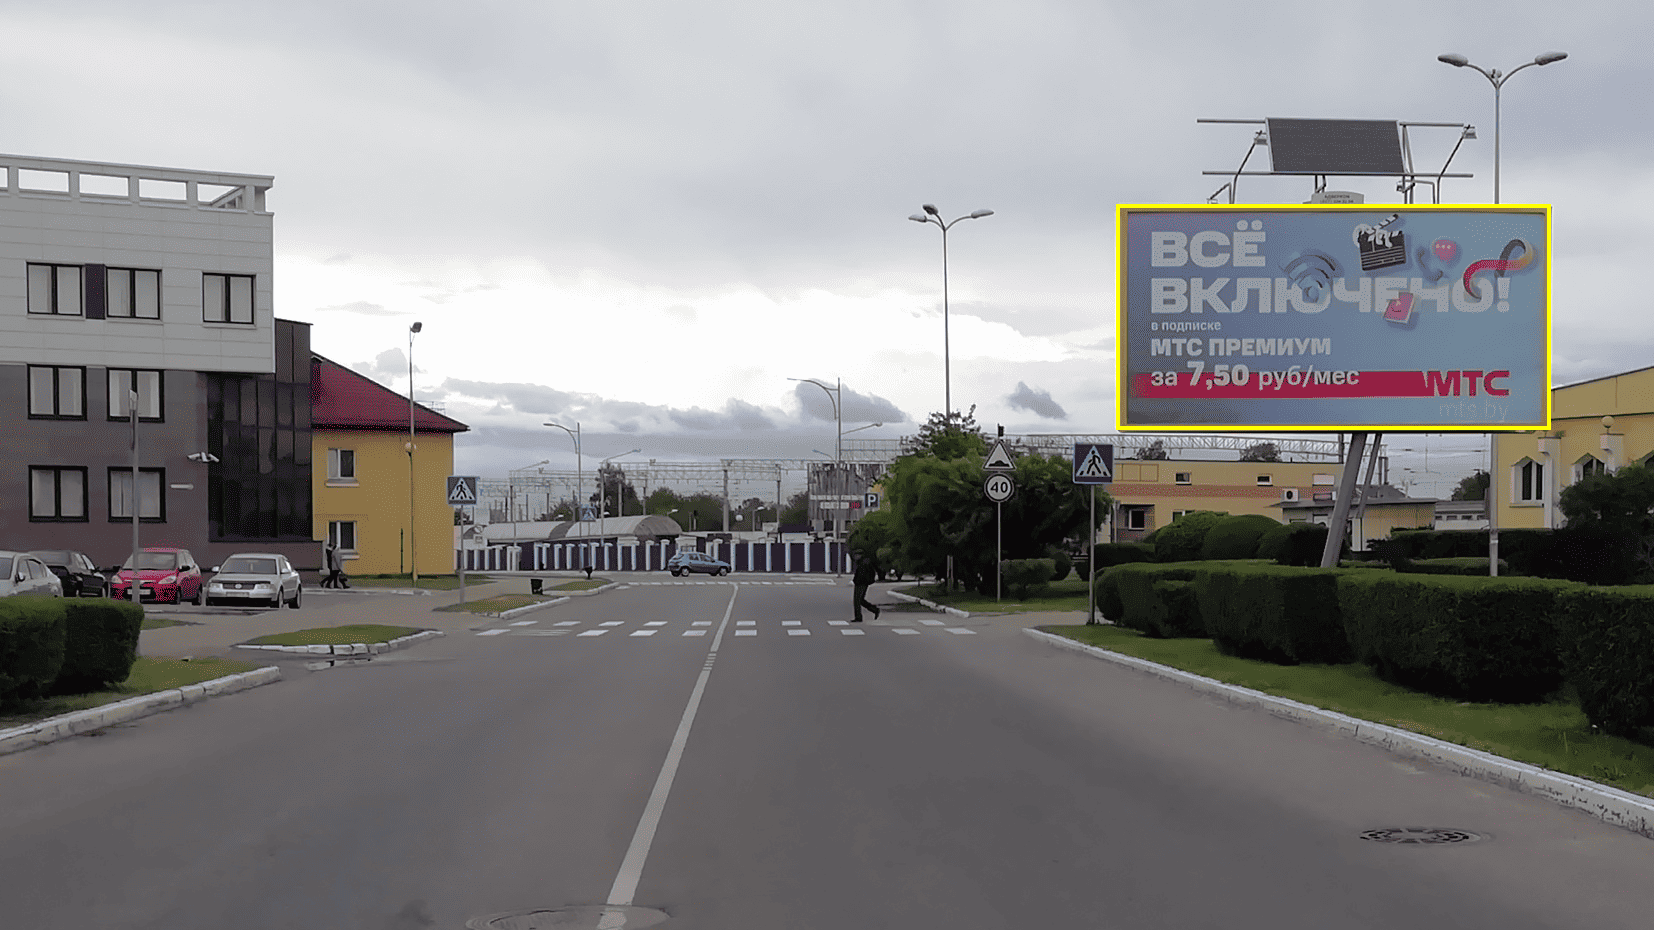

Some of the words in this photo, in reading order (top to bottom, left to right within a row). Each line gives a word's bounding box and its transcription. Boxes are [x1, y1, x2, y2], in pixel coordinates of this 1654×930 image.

[1151, 220, 1266, 268] ВСЁ
[1151, 277, 1511, 314] ВКЛЮЧЕНО!
[1151, 322, 1158, 331] в
[1162, 320, 1221, 333] подписке
[1151, 338, 1203, 356] МТС
[1209, 338, 1331, 356] ПРЕМИУМ
[1151, 370, 1177, 387] за
[1187, 361, 1250, 389] 7,50
[1258, 366, 1360, 390] руб/мес
[1427, 370, 1510, 397] МТС
[990, 482, 1008, 494] 40
[867, 494, 877, 507] P
